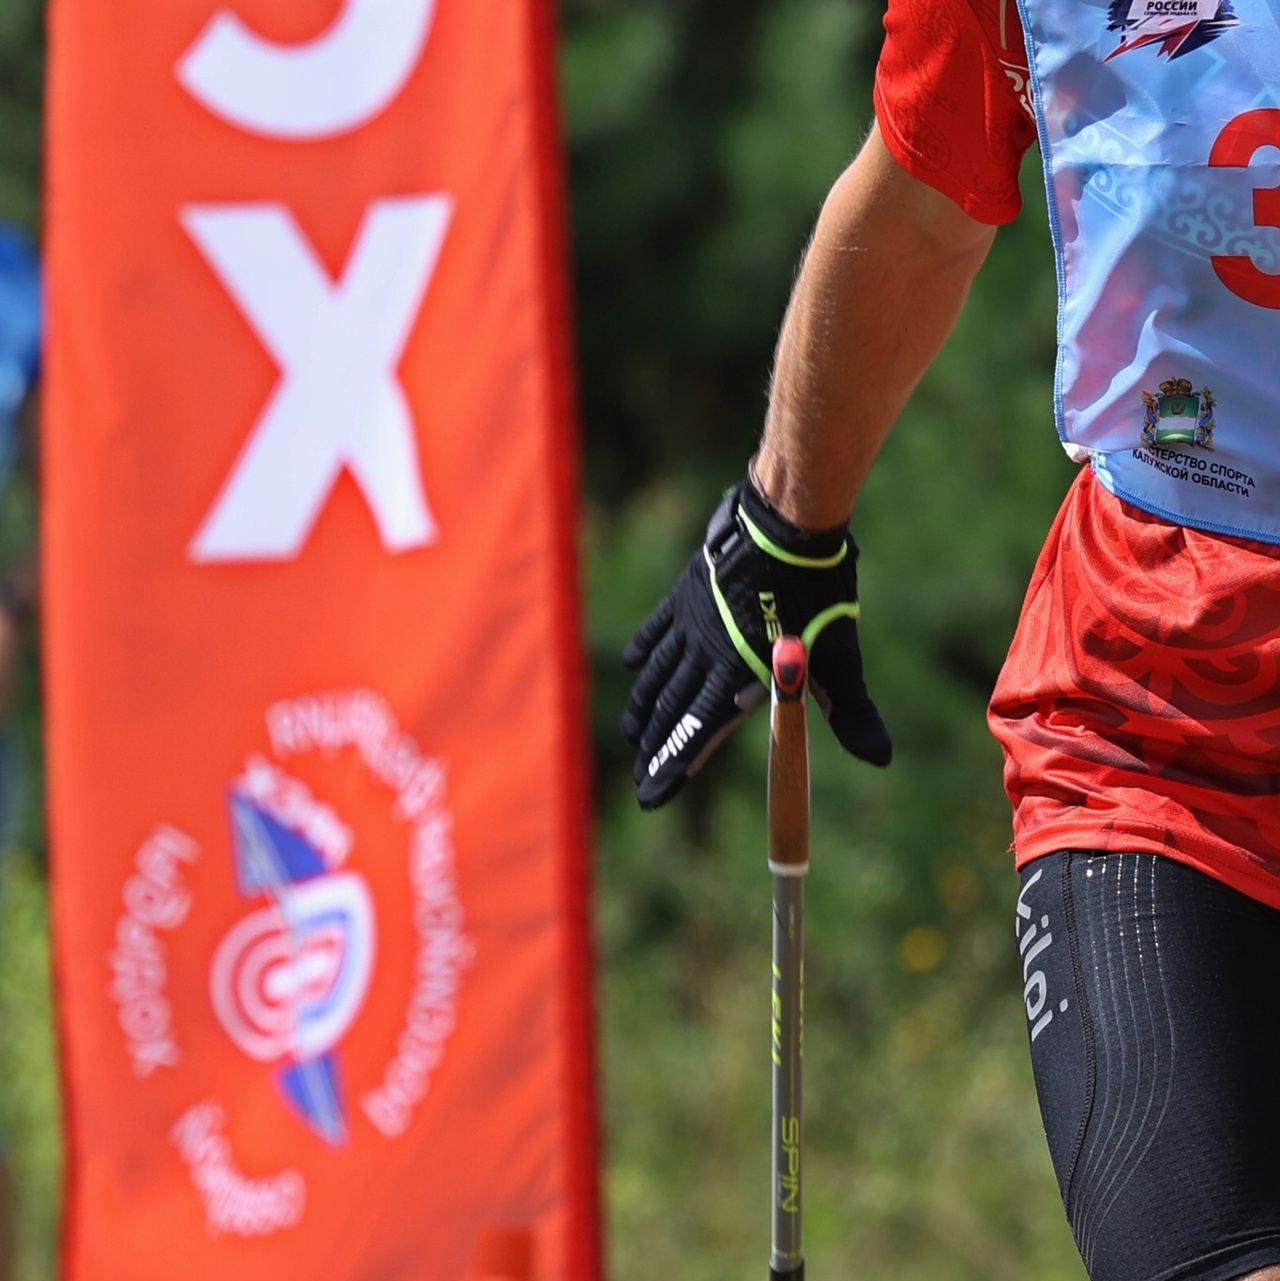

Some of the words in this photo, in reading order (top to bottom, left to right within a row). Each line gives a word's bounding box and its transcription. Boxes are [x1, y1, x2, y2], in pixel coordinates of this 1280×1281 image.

[1146, 1, 1198, 11] РОССИИ
[1147, 446, 1207, 471] СТЕРСТВО
[1209, 463, 1256, 488] СПОРТА
[1191, 473, 1250, 497] ОБЛАСТИ
[758, 592, 783, 642] EKI
[782, 1115, 799, 1212] SPIN
